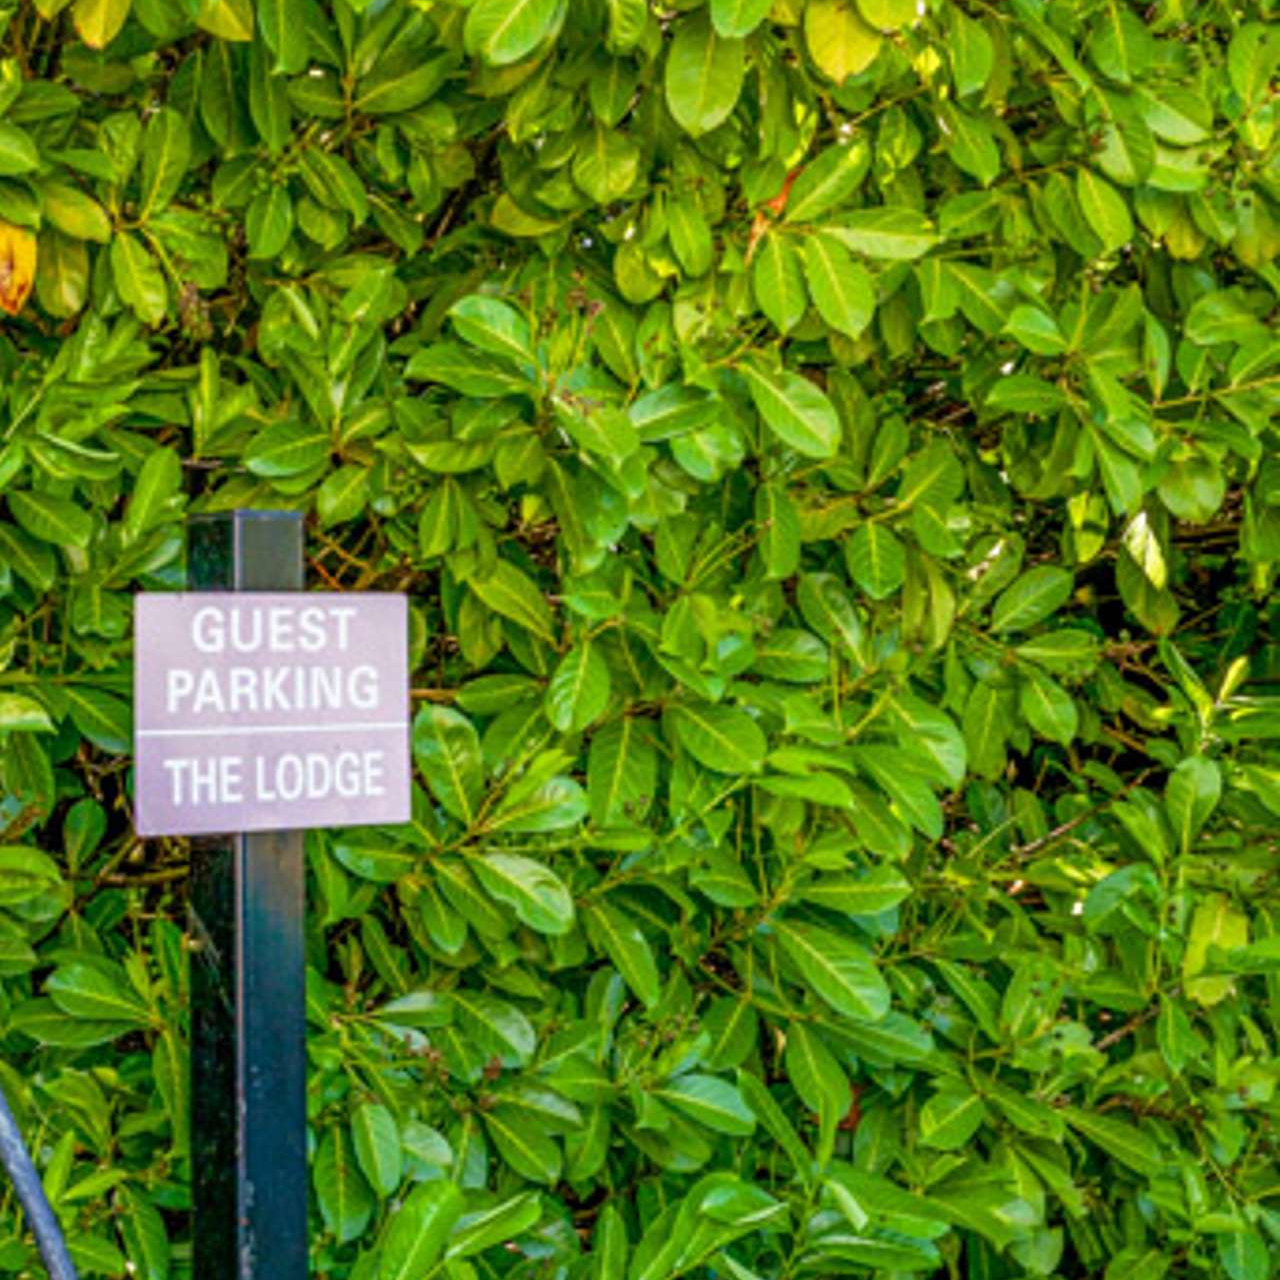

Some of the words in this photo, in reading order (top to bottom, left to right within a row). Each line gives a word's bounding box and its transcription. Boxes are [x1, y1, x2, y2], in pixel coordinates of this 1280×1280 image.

[191, 606, 357, 653] GUEST
[166, 665, 380, 713] PARKING
[163, 755, 243, 806] THE
[255, 750, 386, 801] LODGE
